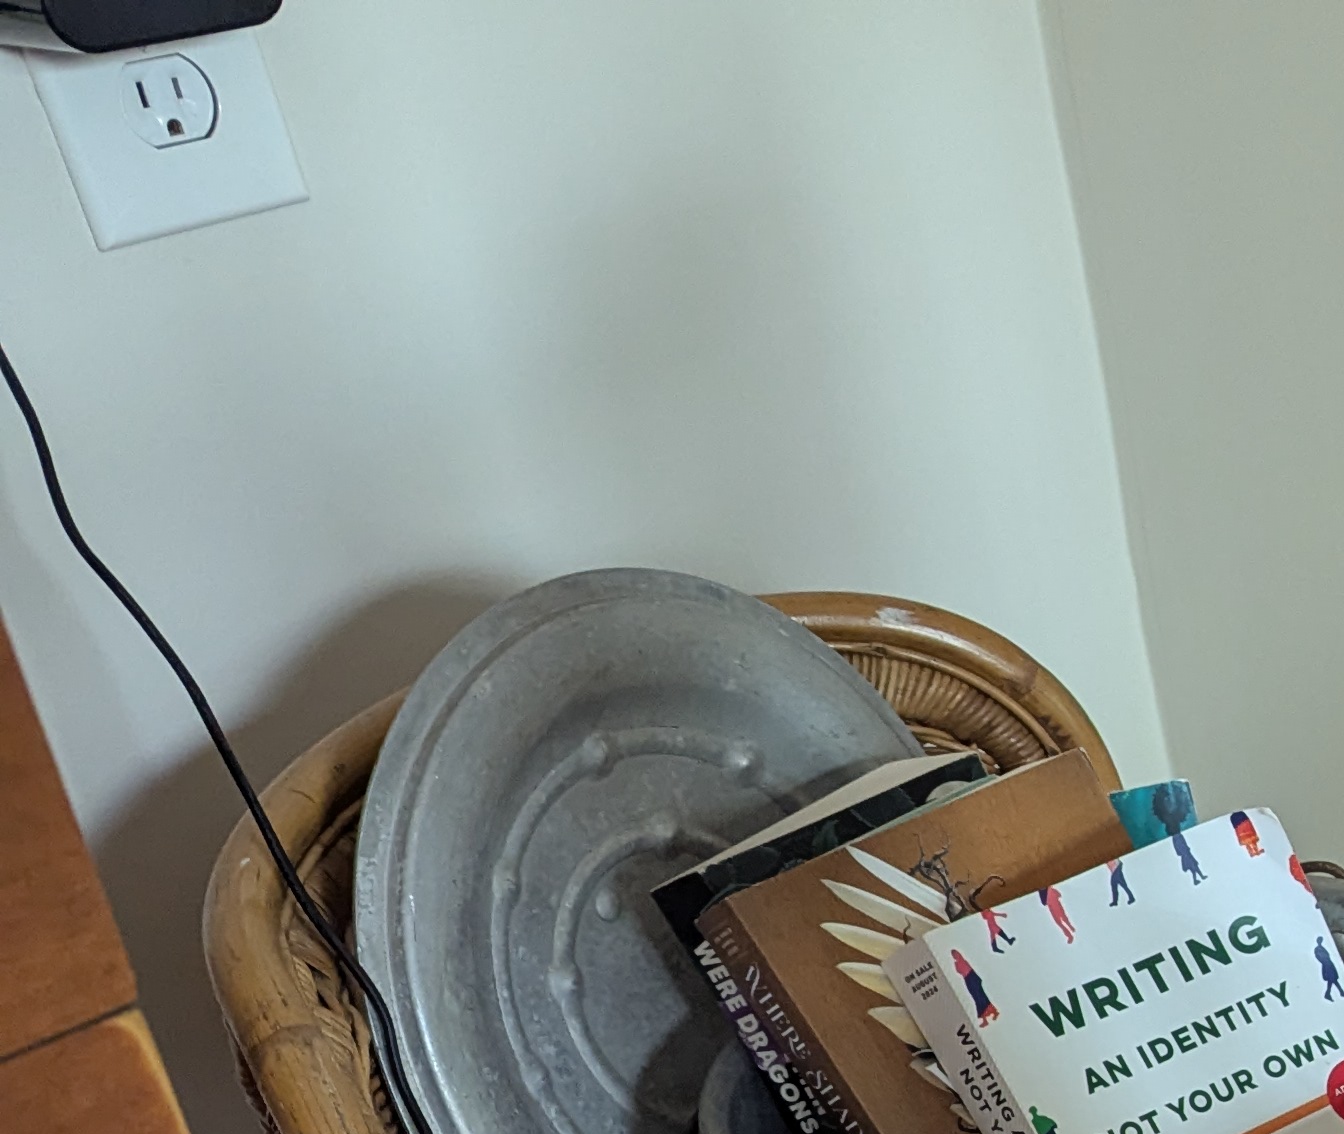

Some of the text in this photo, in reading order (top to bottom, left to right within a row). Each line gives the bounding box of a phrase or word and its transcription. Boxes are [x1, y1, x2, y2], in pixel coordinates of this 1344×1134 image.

[745, 961, 811, 1060] WHERE
[904, 961, 934, 984] ON SALE
[911, 971, 938, 993] AUGUST
[1028, 915, 1272, 1038] WRITING
[693, 940, 748, 1013] WERE
[736, 1013, 820, 1134] DRAGONS
[956, 1023, 1015, 1123] WRITING
[1083, 980, 1291, 1095] AN IDENTITY
[1165, 1069, 1259, 1123] YOUR
[1262, 1029, 1340, 1079] OWN
[959, 1068, 992, 1113] NOT
